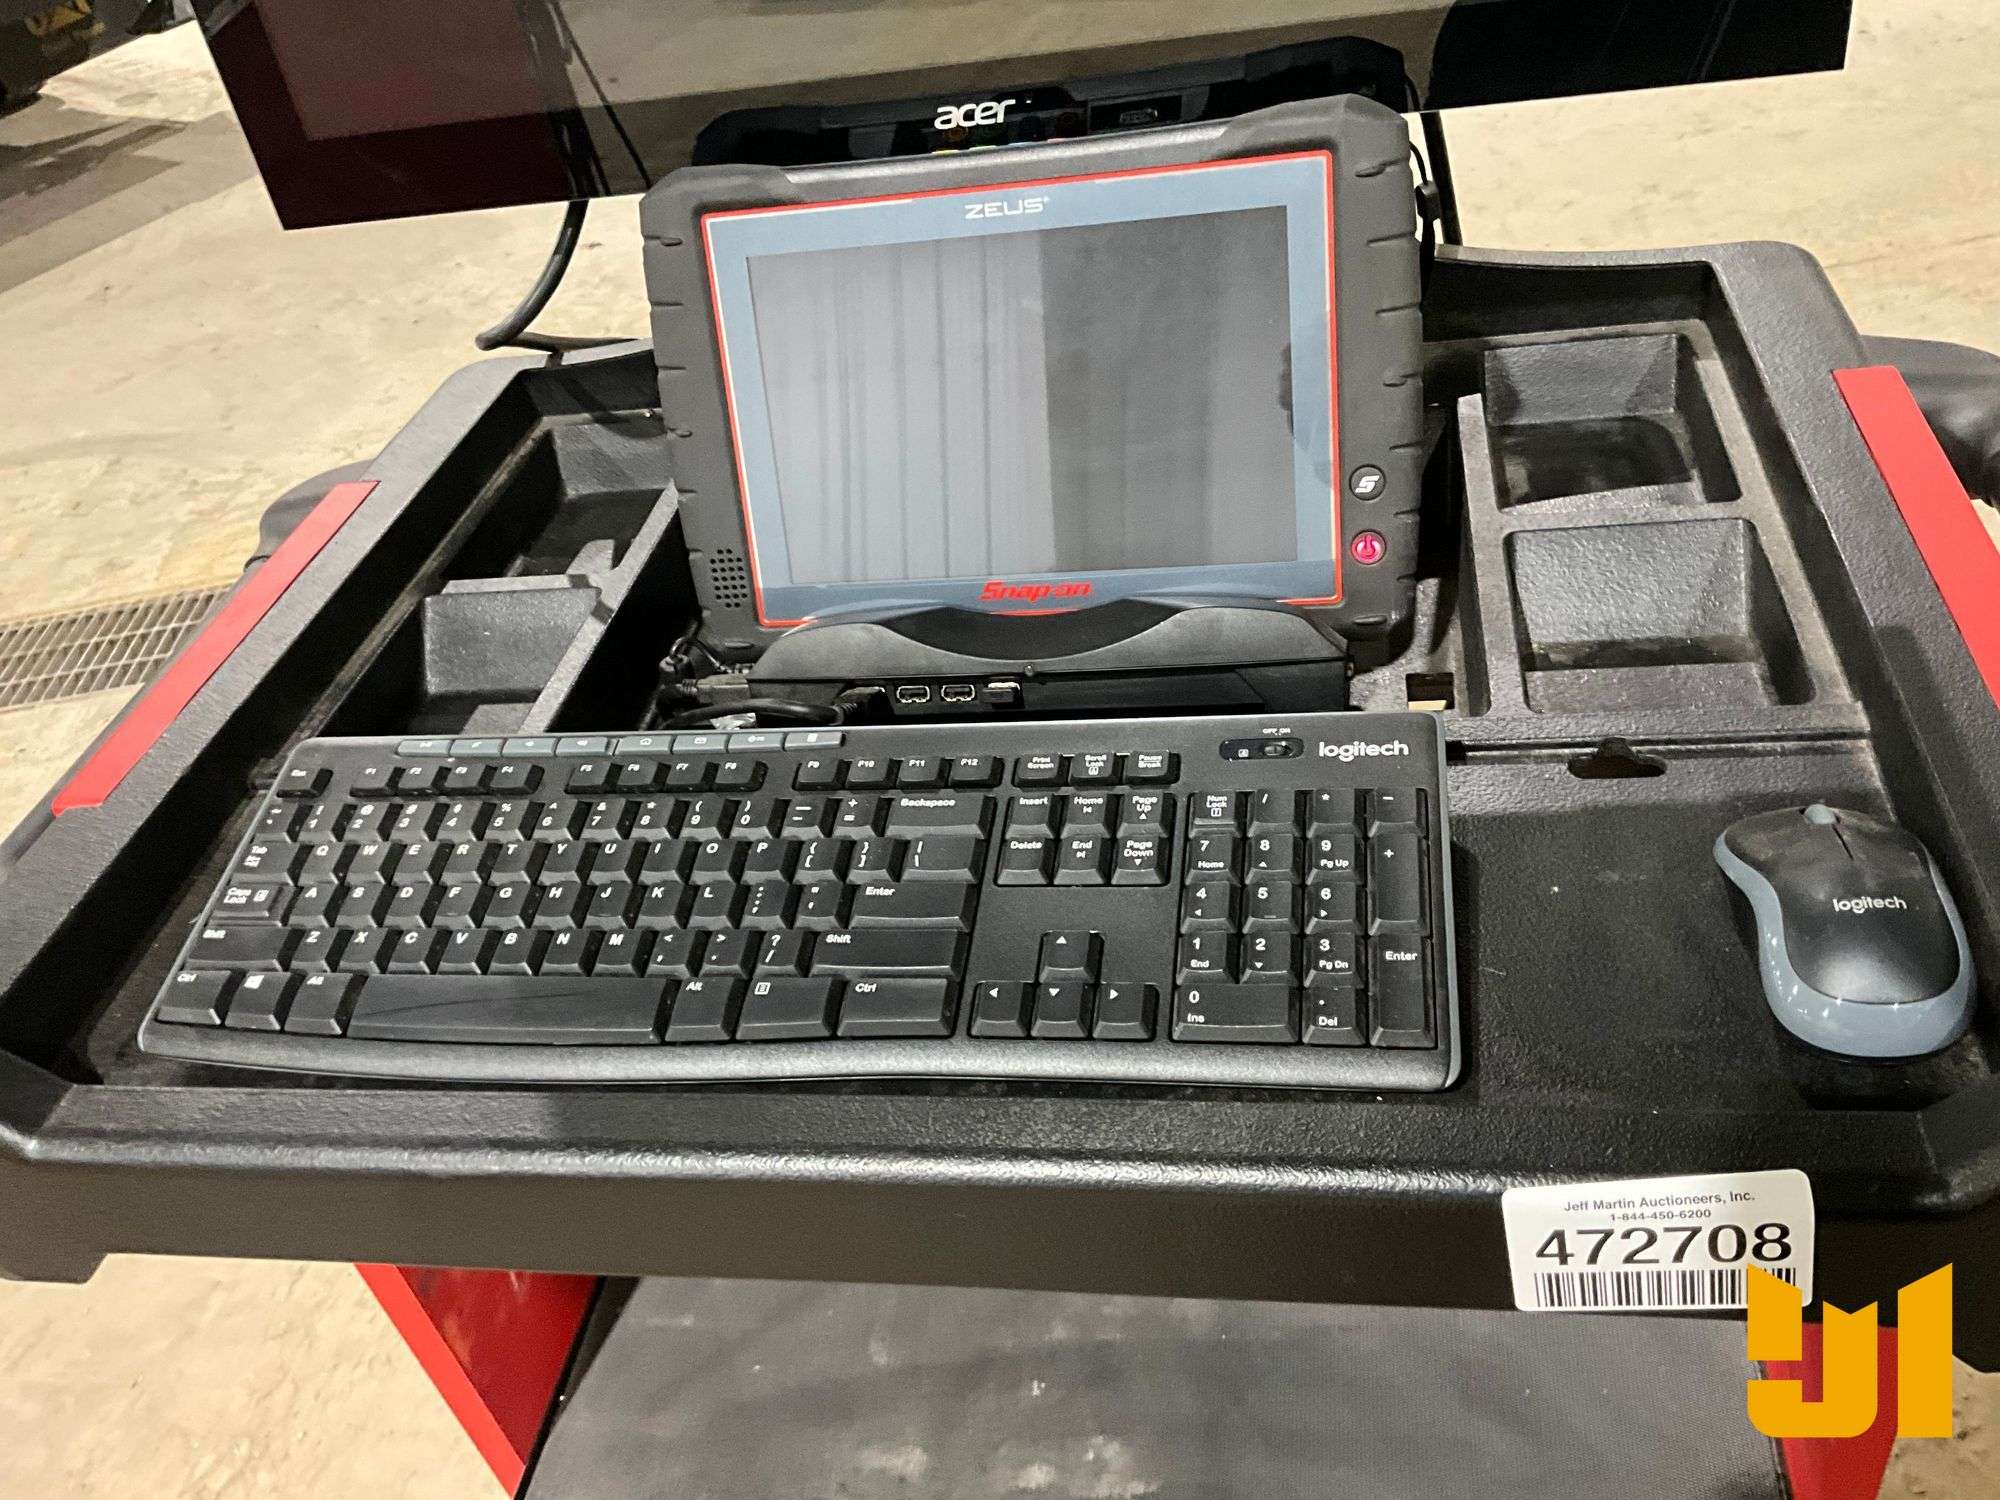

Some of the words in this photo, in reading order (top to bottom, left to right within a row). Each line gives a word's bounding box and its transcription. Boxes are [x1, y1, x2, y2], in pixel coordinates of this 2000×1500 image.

[934, 99, 1015, 130] acer
[964, 198, 1045, 220] ZEUS
[1319, 740, 1409, 762] logitech
[908, 759, 926, 767] F11
[960, 758, 979, 766] F12
[901, 798, 957, 809] Backspace
[1019, 795, 1049, 806] Insert
[1074, 795, 1104, 806] Home
[1131, 794, 1159, 805] Page
[1136, 804, 1152, 813] Up
[352, 818, 364, 829] 2
[399, 817, 410, 828] 3
[493, 816, 505, 827] 5
[542, 816, 553, 827] 6
[591, 815, 602, 826] 7
[640, 815, 651, 826] 8
[690, 814, 701, 825] 9
[740, 814, 751, 825] 0
[408, 844, 422, 855] E
[456, 844, 470, 855] R
[507, 844, 518, 855] T
[557, 843, 568, 854] Y
[604, 843, 617, 854] U
[707, 843, 718, 853] O
[756, 842, 769, 853] P
[1010, 840, 1043, 850] Delete
[1072, 840, 1093, 850] End
[1126, 839, 1153, 850] Page
[1199, 840, 1210, 852] 7
[1259, 839, 1270, 851] 8
[1321, 839, 1332, 852] 9
[1123, 848, 1154, 858] Down
[1198, 861, 1225, 869] Home
[1320, 858, 1334, 868] Pg
[1334, 858, 1349, 868] Up
[304, 887, 317, 898] A
[401, 887, 413, 897] D
[449, 887, 461, 897] F
[499, 887, 513, 898] G
[549, 887, 562, 898] H
[601, 887, 611, 897] J
[652, 887, 664, 897] K
[703, 886, 713, 898] L
[865, 886, 896, 896] Enter
[1196, 888, 1206, 898] 4
[1257, 887, 1268, 899] 5
[1321, 888, 1331, 899] 6
[1833, 896, 1908, 914] logitech
[307, 931, 320, 942] Z
[355, 932, 368, 943] X
[405, 932, 417, 943] C
[457, 933, 468, 943] V
[505, 933, 517, 944] B
[557, 934, 570, 944] N
[609, 934, 623, 945] M
[771, 934, 781, 947] ?
[826, 934, 851, 944] Shift
[1192, 937, 1201, 950] 1
[1255, 937, 1266, 951] 2
[1320, 939, 1330, 951] 3
[1385, 950, 1418, 961] Enter
[1190, 959, 1210, 968] End
[1319, 959, 1333, 969] Pg
[1334, 959, 1349, 969] Dn
[686, 981, 704, 991] Alt
[855, 983, 877, 993] Ctrl
[1189, 991, 1199, 1003] 0
[1187, 1013, 1205, 1023] Ins
[1318, 1016, 1338, 1027] Del
[1564, 1200, 1589, 1212] Jeff
[1593, 1198, 1636, 1211] Martin
[1639, 1190, 1727, 1208] Auctioneers,
[1729, 1190, 1756, 1203] Inc.
[1610, 1208, 1712, 1222] 1-844-450-6200
[1535, 1222, 1793, 1266] 472708
